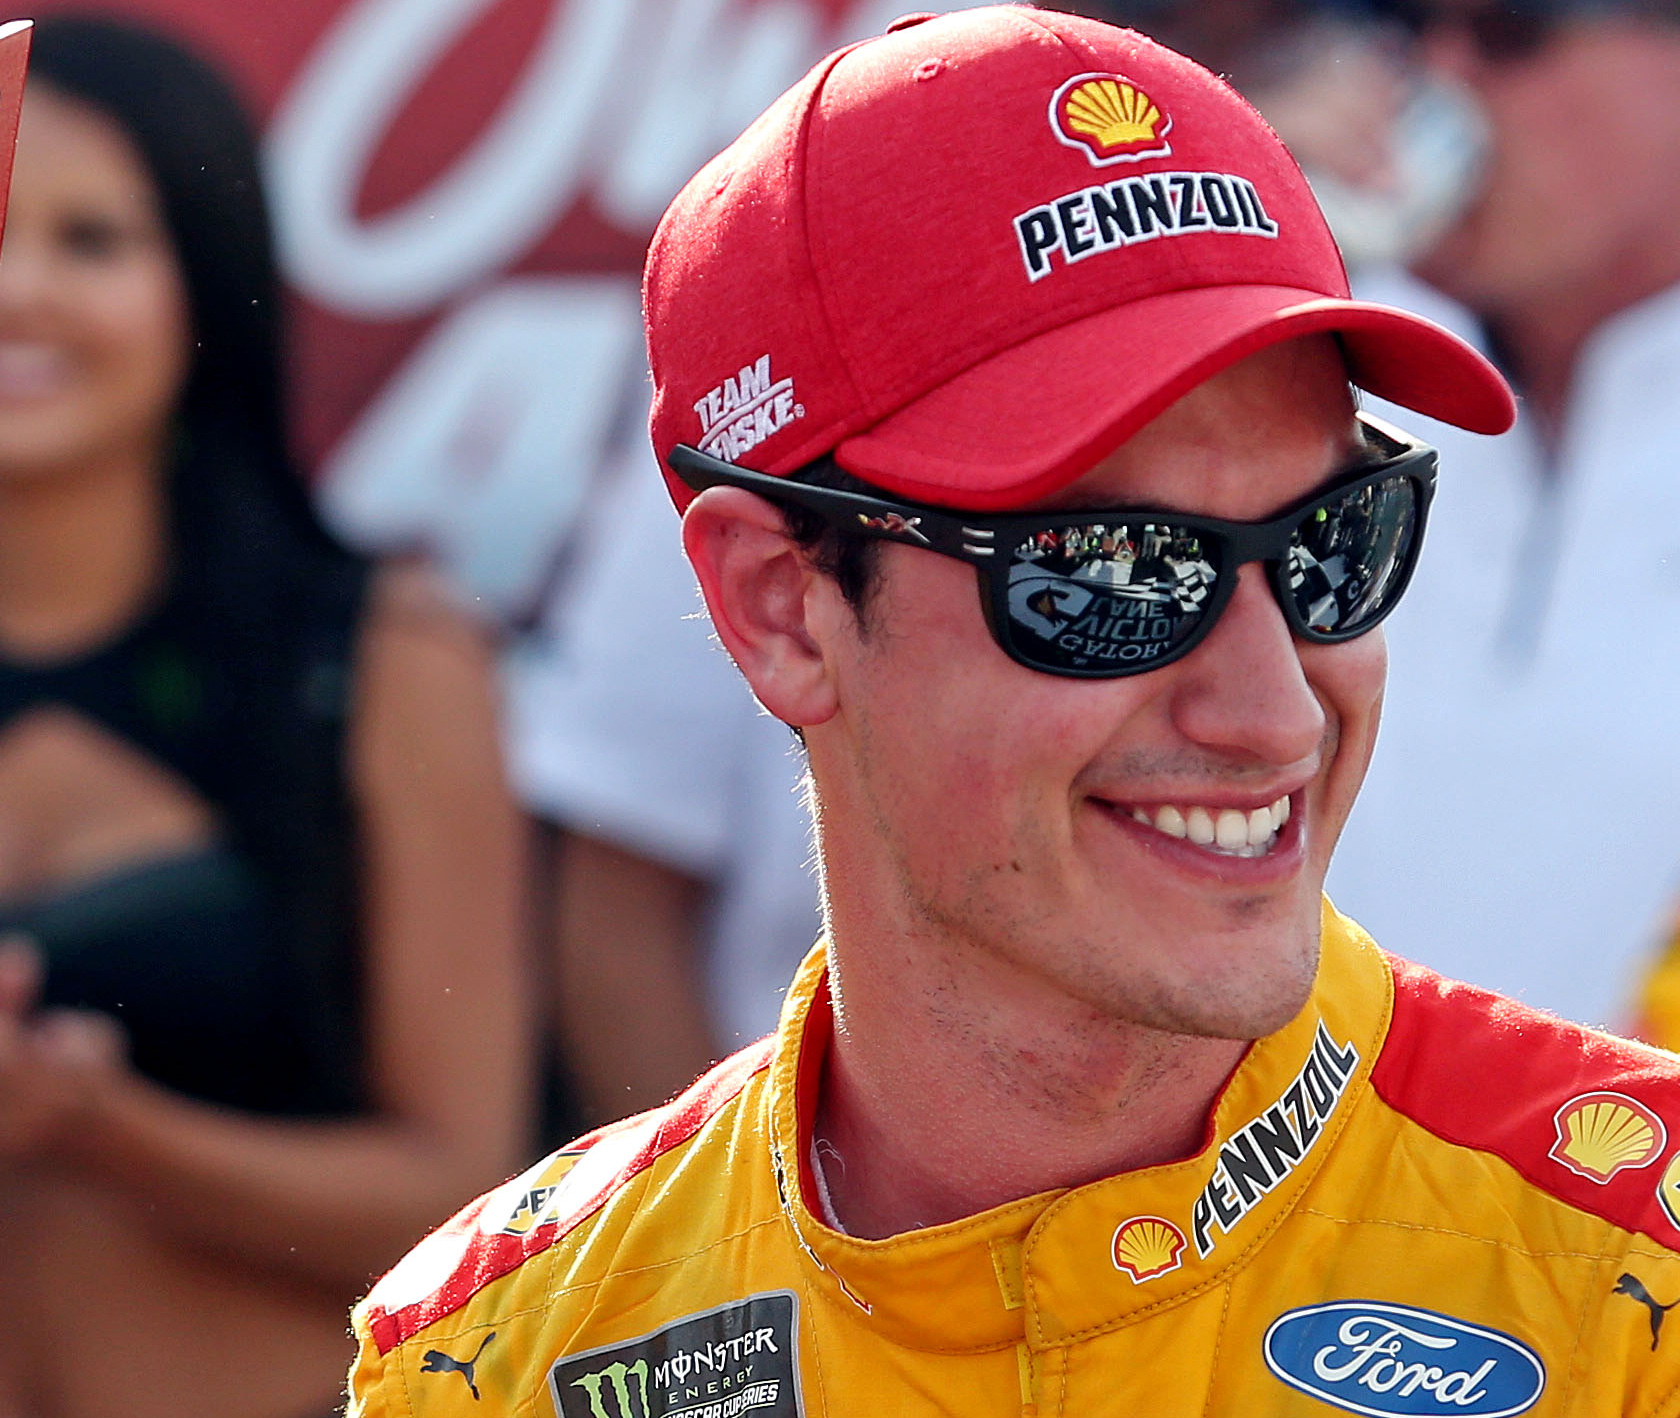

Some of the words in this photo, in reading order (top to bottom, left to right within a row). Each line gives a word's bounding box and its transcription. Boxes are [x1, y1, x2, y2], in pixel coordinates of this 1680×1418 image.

[1014, 174, 1279, 283] PENNZOIL
[693, 354, 769, 433] TEAM
[1193, 1020, 1359, 1258] PENNZOIL
[654, 1327, 779, 1389] MONSTER
[667, 1365, 754, 1404] ENERGY
[1314, 1314, 1498, 1406] Ford
[722, 1395, 742, 1418] CUP
